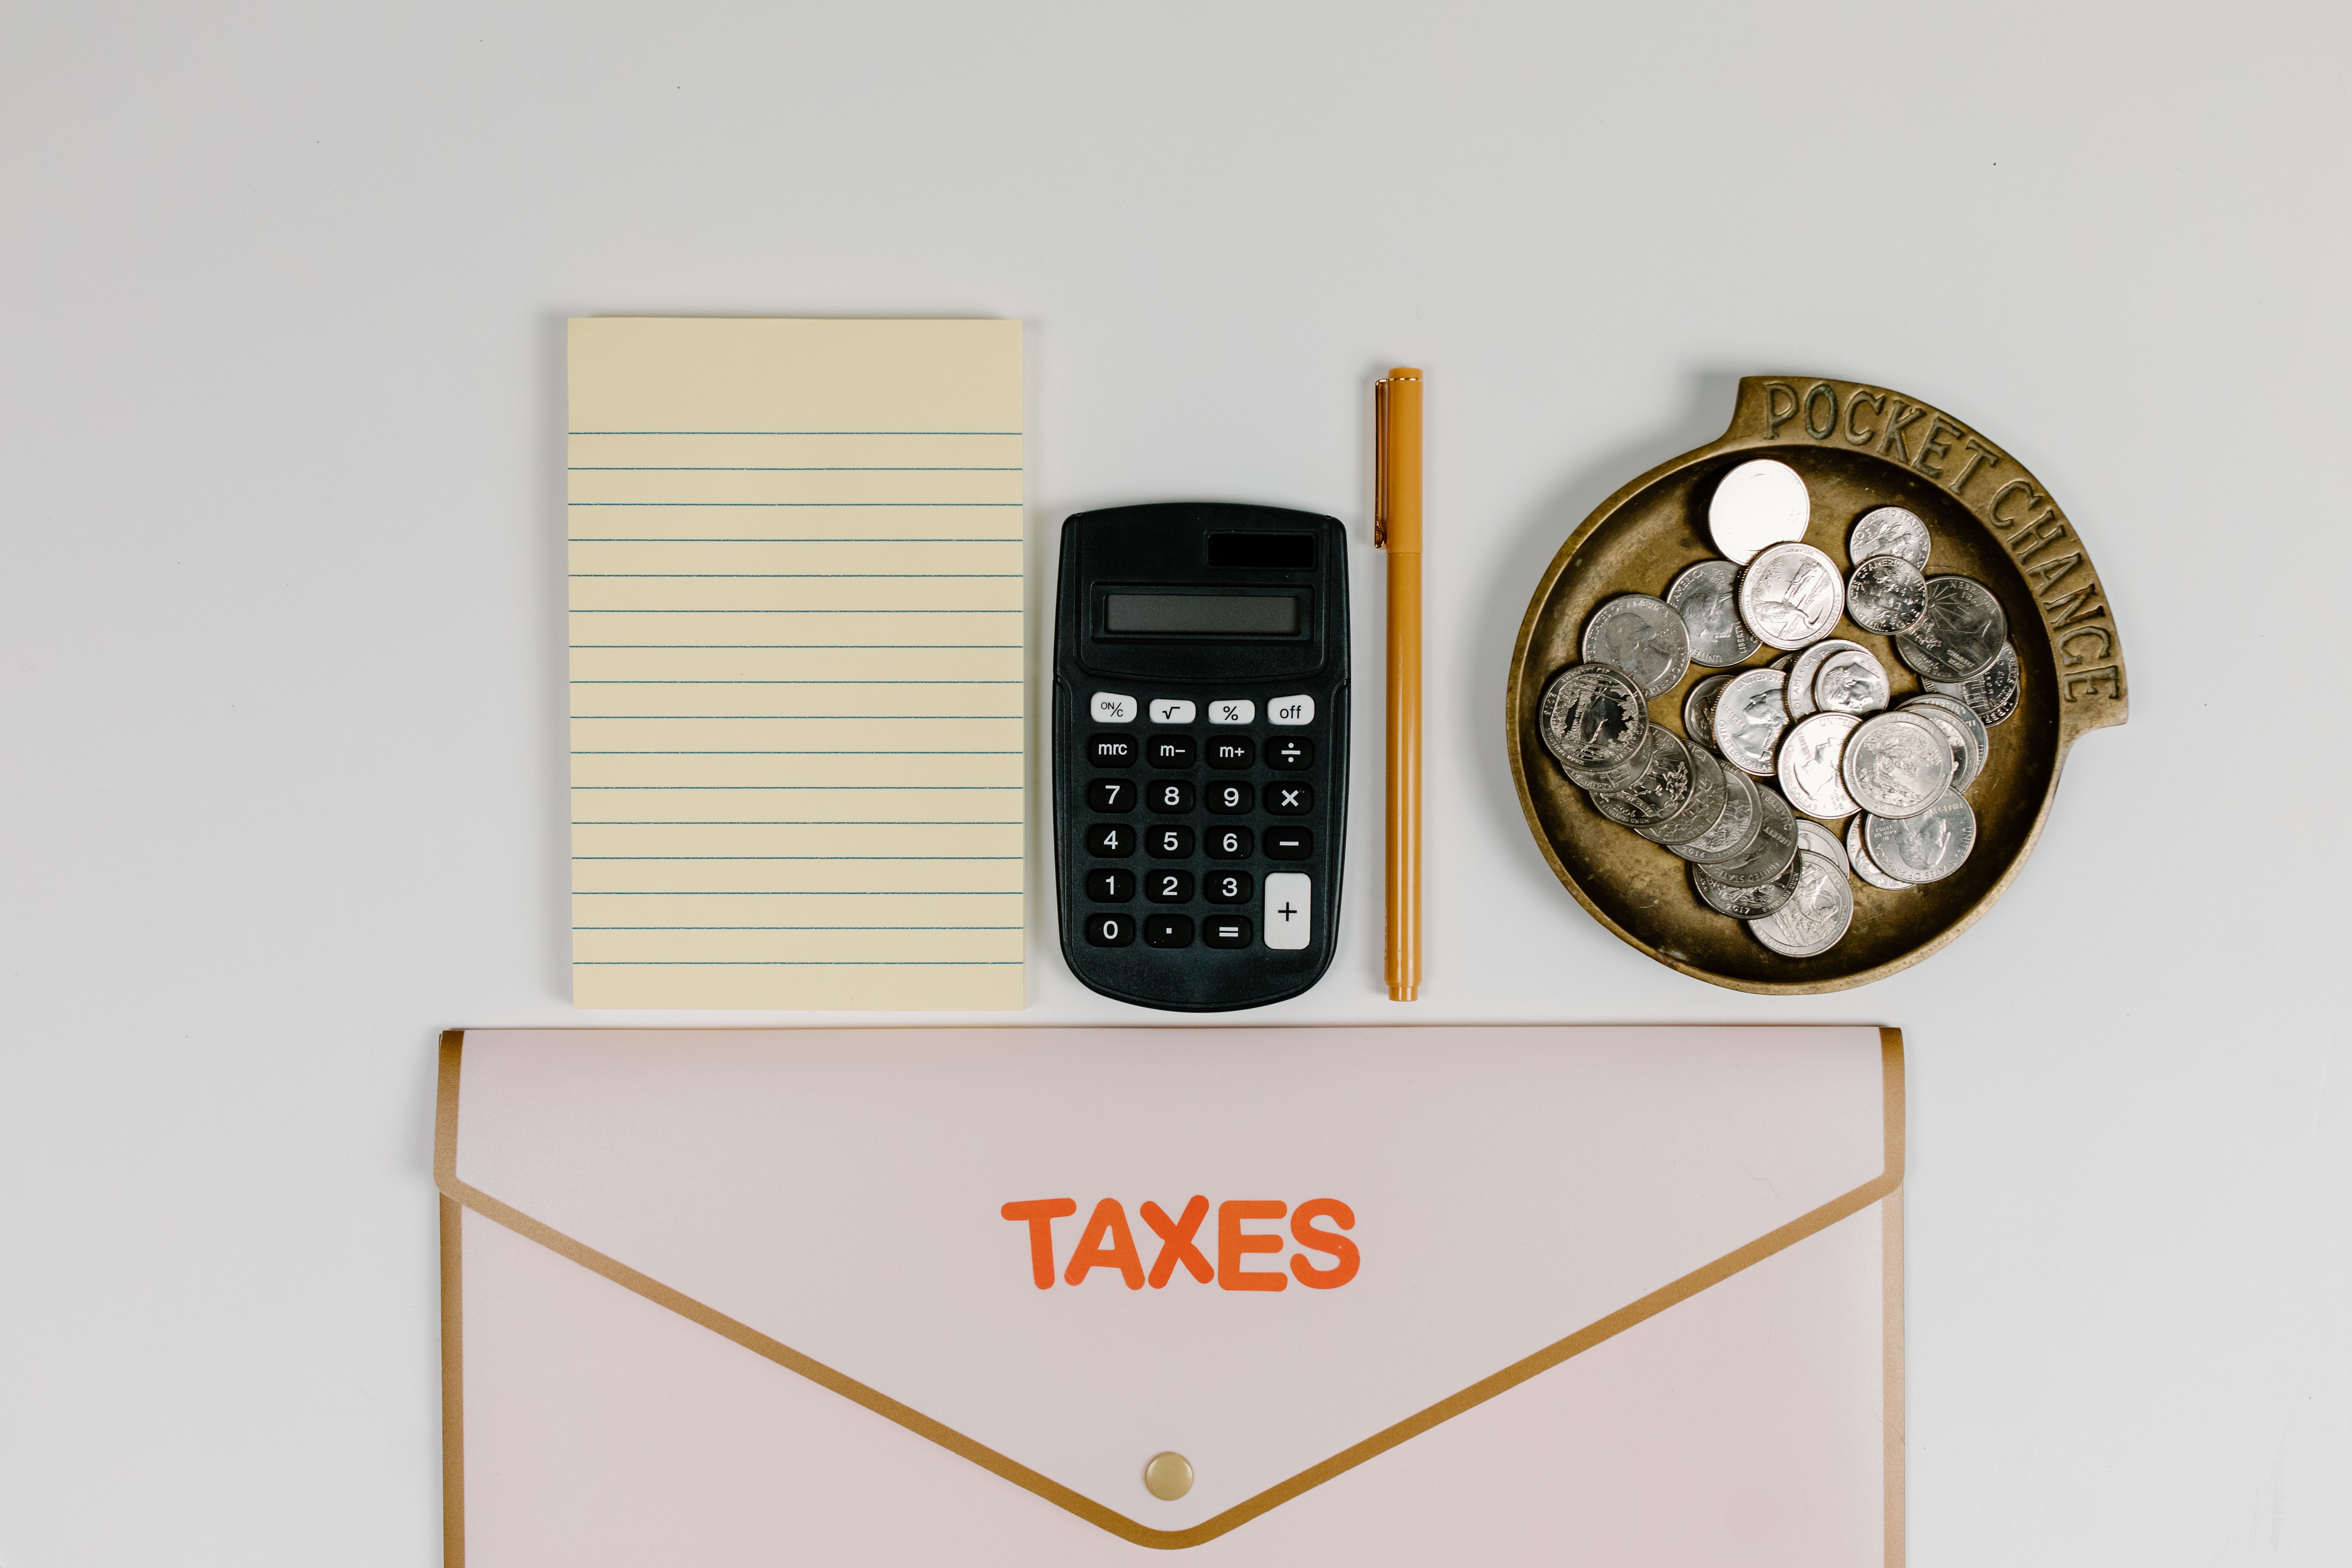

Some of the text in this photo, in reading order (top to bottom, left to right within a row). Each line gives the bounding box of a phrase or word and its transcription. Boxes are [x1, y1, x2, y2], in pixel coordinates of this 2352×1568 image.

[1865, 510, 1896, 525] UNITED
[1899, 512, 1925, 537] STATES
[1763, 381, 2120, 703] POCKET CHANGE
[1625, 599, 1671, 619] AMERICA
[1735, 625, 1748, 654] LIBERTY
[1734, 672, 1765, 692] UNITED
[1792, 653, 1817, 711] OF AMERICA
[1280, 705, 1301, 719] off
[1819, 717, 1854, 728] UNITED
[1718, 719, 1739, 759] QUARTER
[1797, 732, 1813, 760] LIBERTY
[1099, 744, 1127, 755] mrc
[1220, 746, 1244, 757] m+
[1783, 742, 1817, 812] QUARTER DOLLAR
[1105, 785, 1120, 804] 7
[1164, 787, 1180, 805] 8
[1224, 788, 1239, 807] 9
[1764, 791, 1792, 831] QUARTER
[1104, 830, 1118, 849] 4
[1163, 832, 1178, 851] 5
[1223, 833, 1238, 852] 6
[1850, 823, 1859, 852] IN GOD
[1681, 845, 1704, 859] 2016
[1872, 844, 1907, 878] AMERICA
[1712, 866, 1745, 883] STATES
[1747, 861, 1781, 882] UNITED
[1826, 867, 1845, 890] 2016
[1908, 870, 1922, 880] OF
[1924, 858, 1957, 879] STATES
[1106, 876, 1114, 894] 1
[1162, 876, 1178, 896] 2
[1222, 877, 1237, 897] 3
[1723, 902, 1749, 915] 2017
[1103, 920, 1118, 939] 0
[1759, 929, 1798, 954] THEODORE
[1000, 1194, 1360, 1292] TAXES
